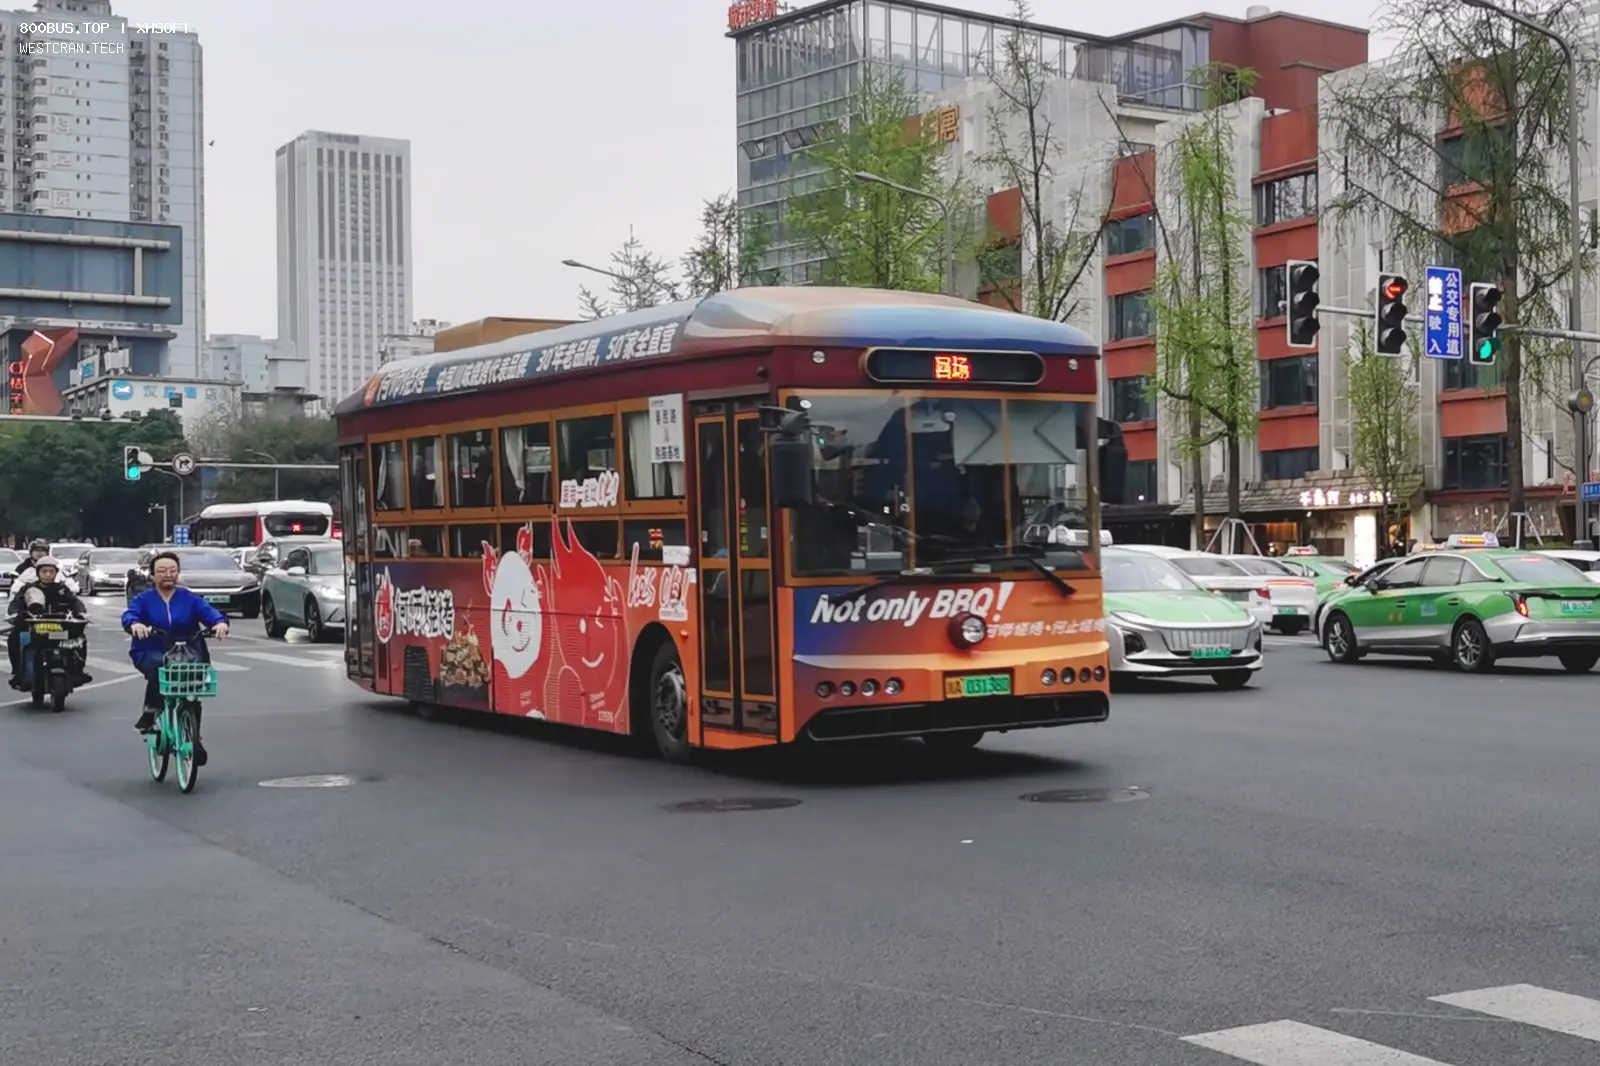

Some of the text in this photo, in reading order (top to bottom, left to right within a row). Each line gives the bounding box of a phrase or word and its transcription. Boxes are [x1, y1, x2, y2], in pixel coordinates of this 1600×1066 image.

[1446, 272, 1460, 355] 公交专用道
[810, 581, 1015, 628] Not only BBQ!
